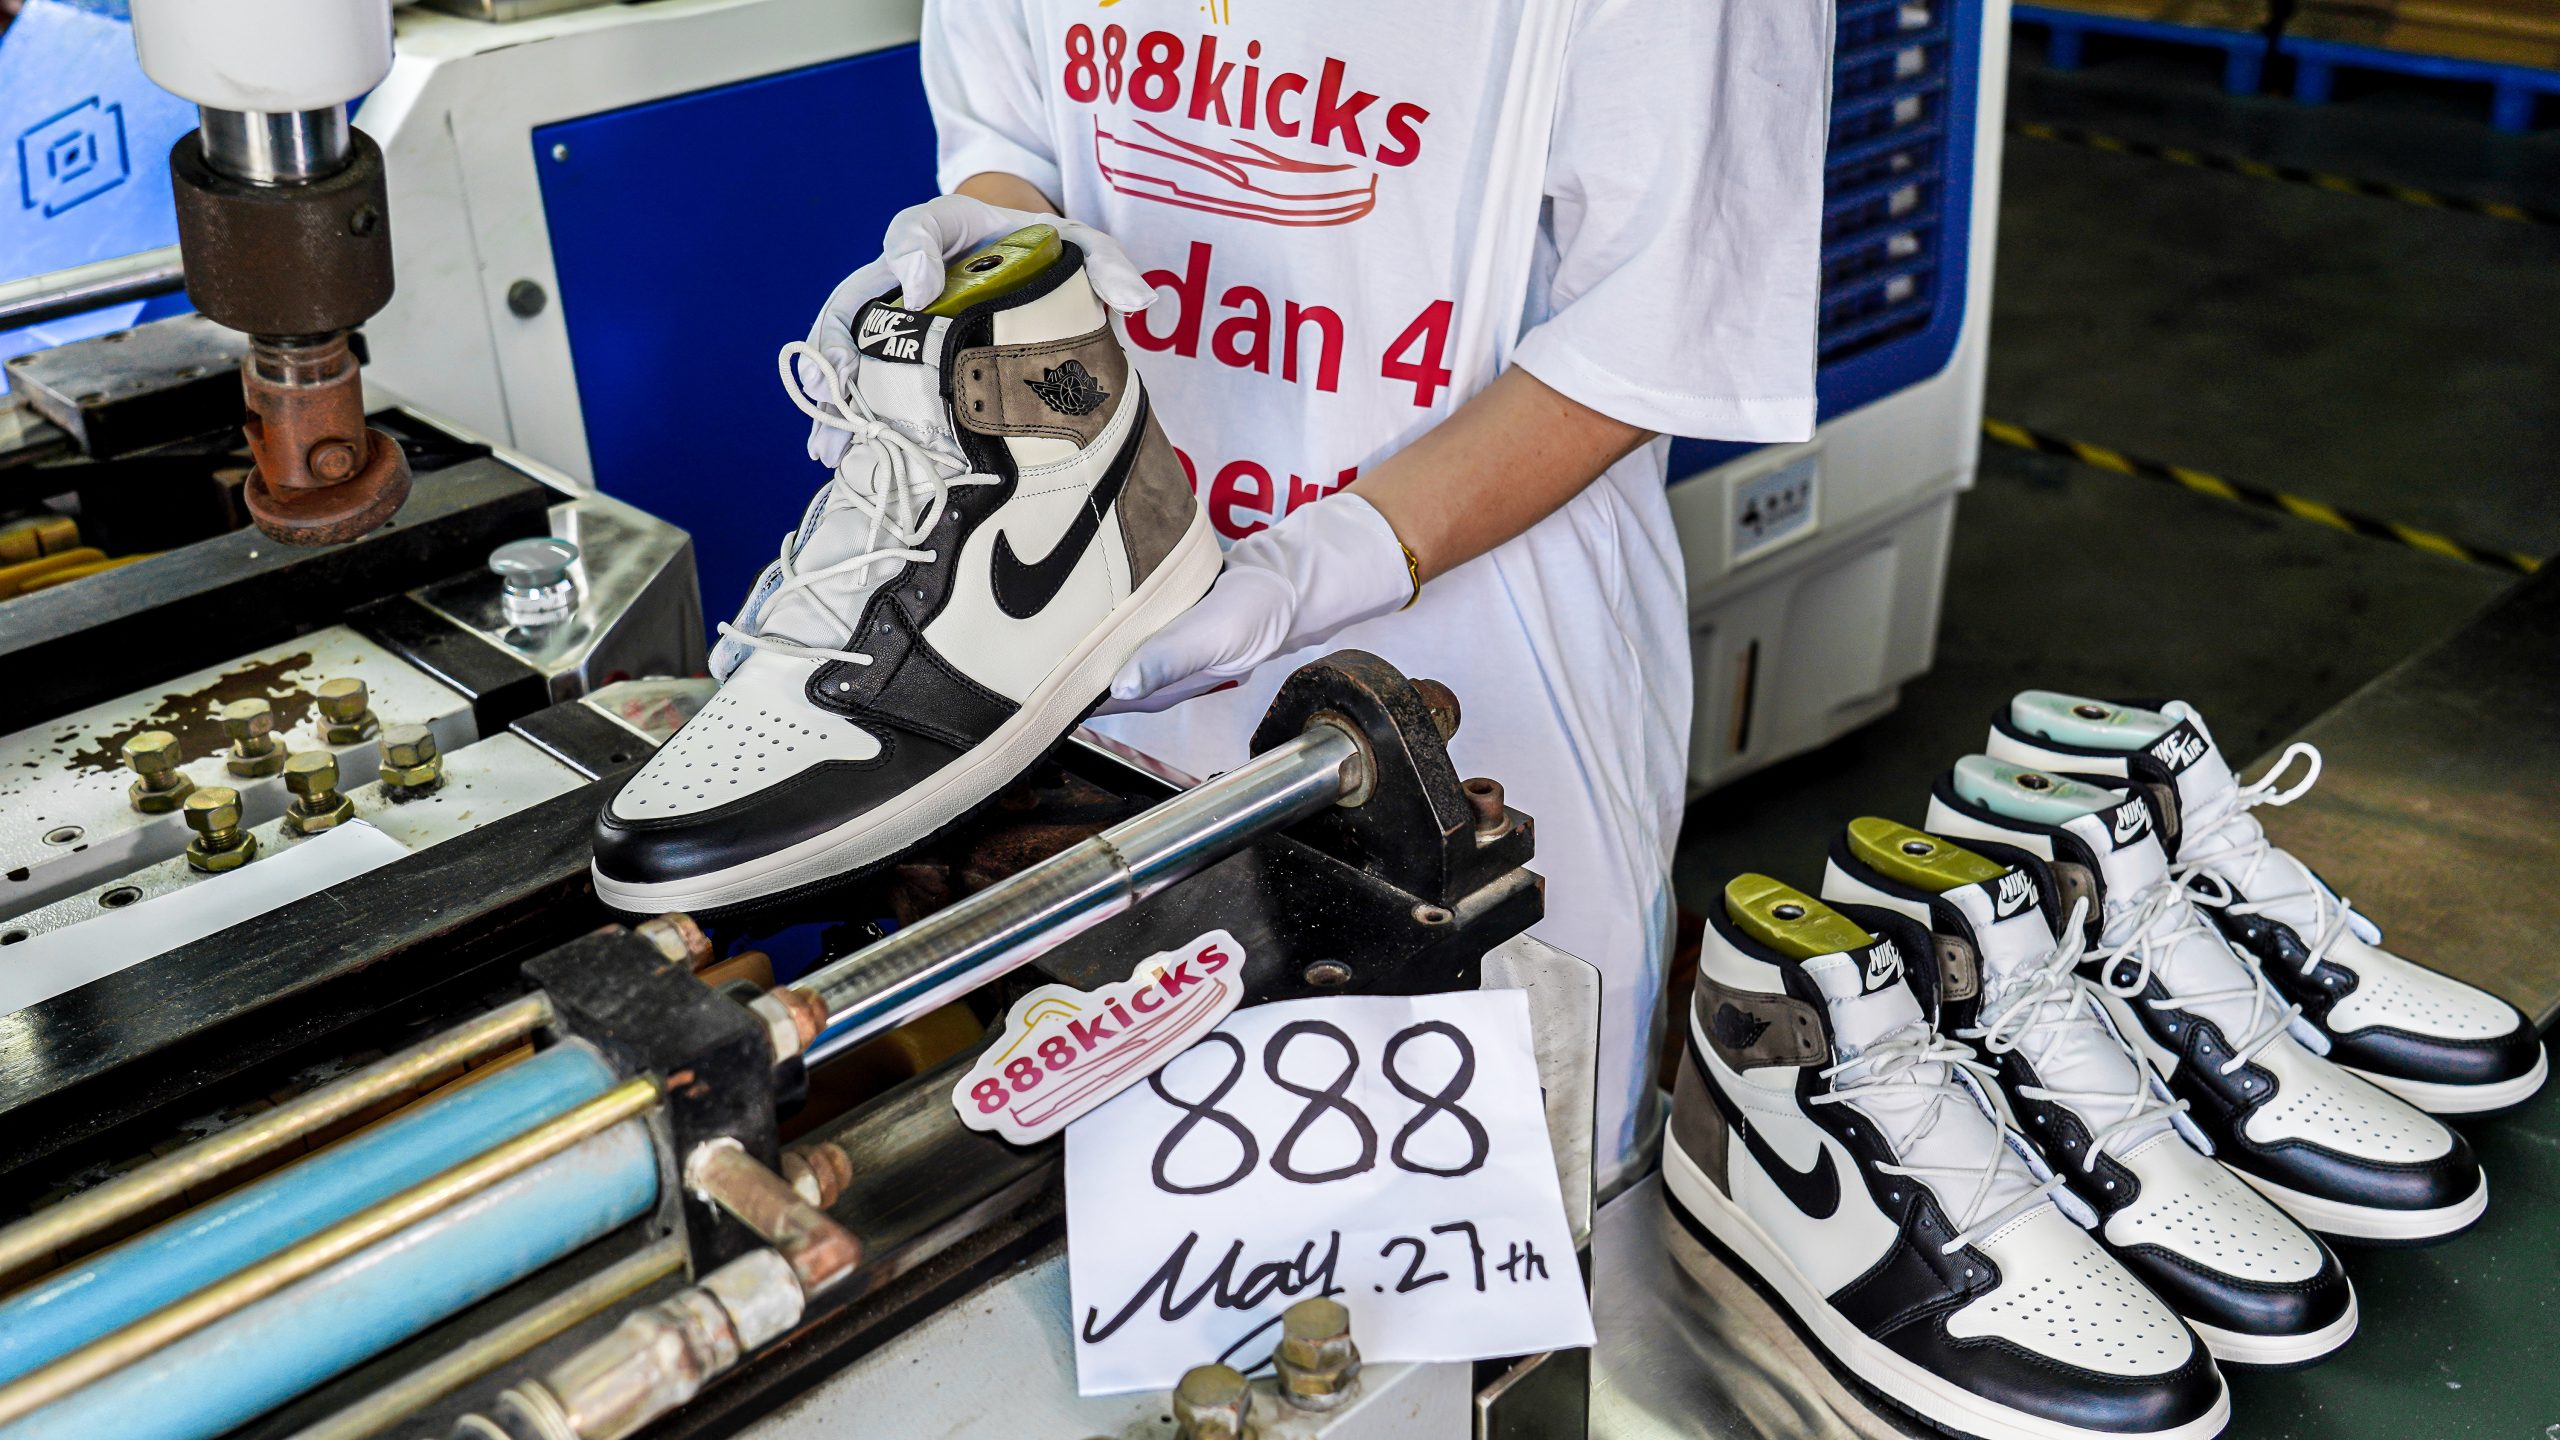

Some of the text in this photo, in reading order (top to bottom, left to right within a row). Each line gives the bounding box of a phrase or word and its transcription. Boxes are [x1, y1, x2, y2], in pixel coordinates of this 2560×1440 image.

[1064, 23, 1430, 167] 888kicks
[863, 307, 907, 334] NIKE
[882, 336, 920, 360] AIR
[1381, 299, 1454, 408] 4
[2180, 737, 2205, 767] AIR
[971, 944, 1229, 1114] 888kicks
[1148, 1020, 1489, 1195] 888
